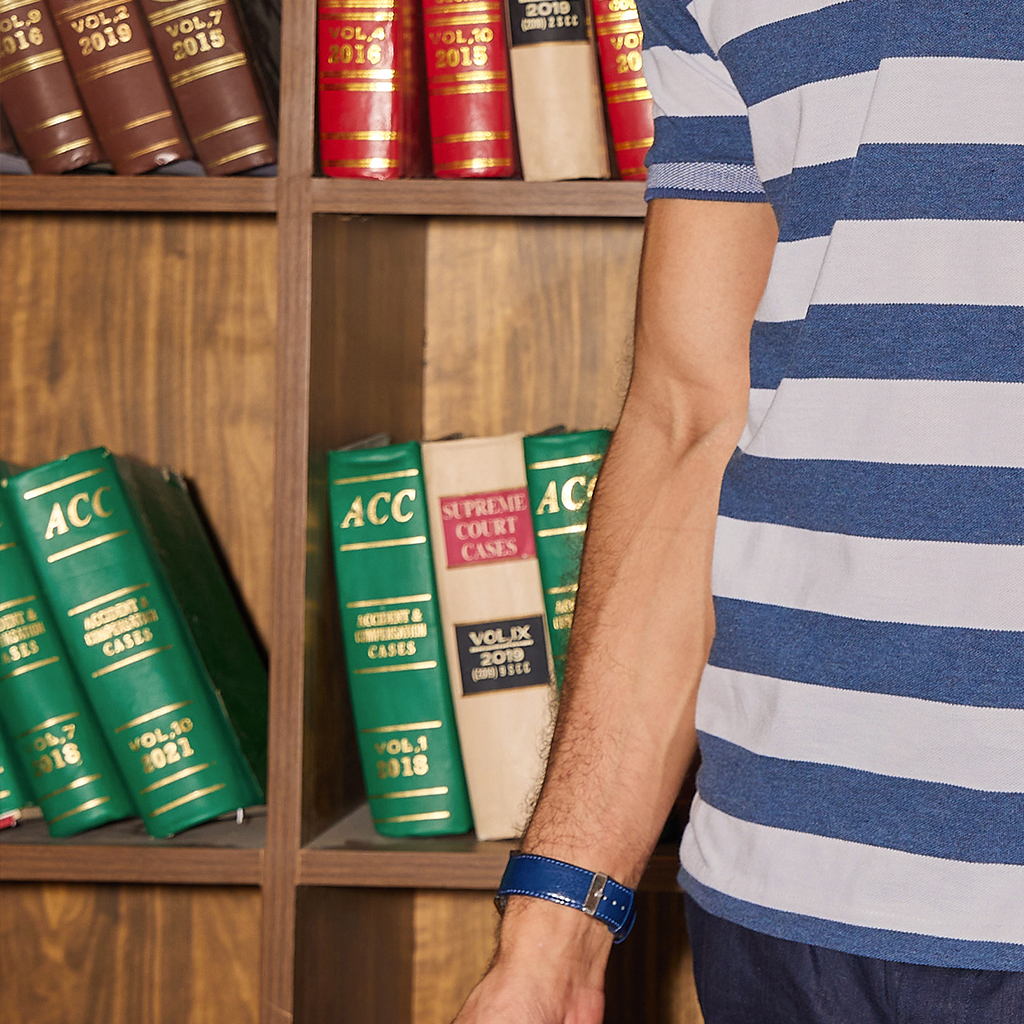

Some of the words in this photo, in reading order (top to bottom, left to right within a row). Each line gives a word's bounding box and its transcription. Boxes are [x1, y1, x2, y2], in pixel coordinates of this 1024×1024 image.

[525, 1, 571, 17] 2019
[2, 26, 44, 54] 016
[79, 23, 133, 56] 2019
[172, 28, 225, 61] 2015
[328, 44, 382, 64] 2016
[435, 45, 489, 68] 2015
[616, 50, 643, 74] 20
[442, 492, 527, 520] SUPREME
[536, 476, 598, 515] AC
[45, 486, 113, 540] ACC
[340, 488, 417, 529] ACC
[455, 516, 518, 541] COURT
[461, 538, 518, 562] CASES
[411, 608, 423, 623] &
[2, 639, 39, 664] ASES
[102, 628, 153, 657] CASES
[367, 640, 417, 659] CASES
[480, 647, 525, 666] 2019
[32, 742, 81, 777] 2018
[141, 737, 194, 774] 2021
[376, 754, 430, 779] 2018
